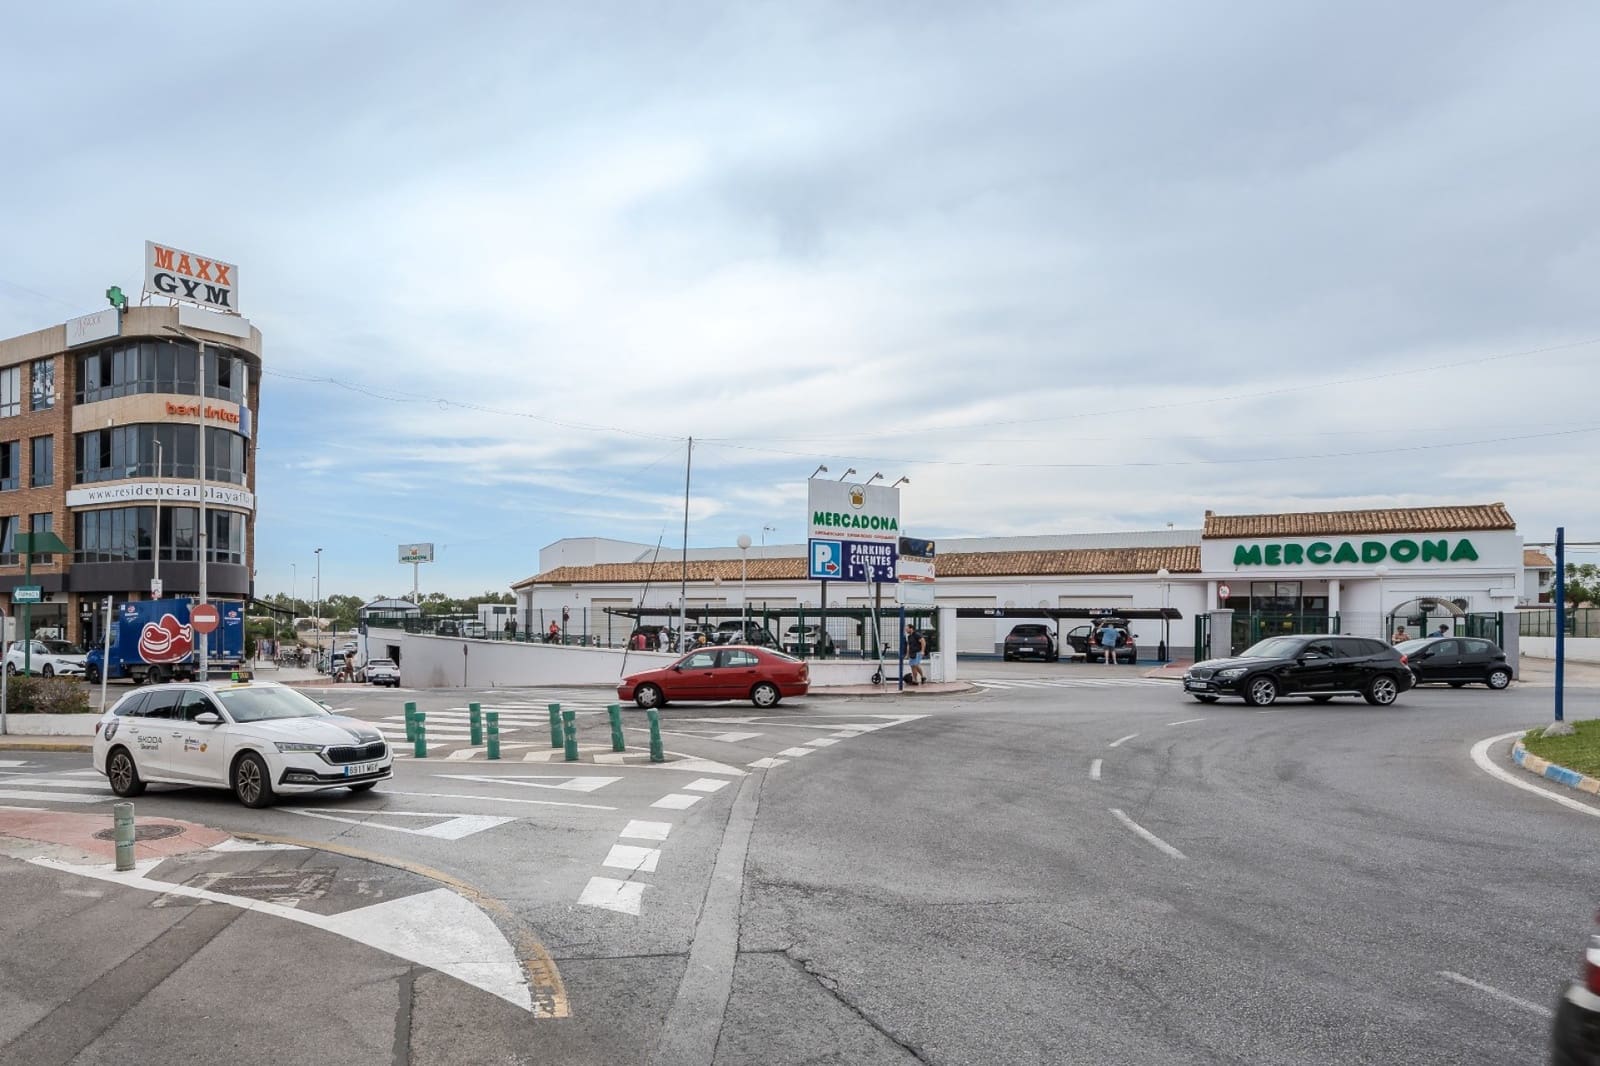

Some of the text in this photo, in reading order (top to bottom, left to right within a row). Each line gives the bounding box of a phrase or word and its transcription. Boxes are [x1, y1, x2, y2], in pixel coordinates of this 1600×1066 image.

[154, 246, 231, 286] MAXX
[153, 272, 231, 307] GYM
[813, 511, 898, 531] MERCADONA
[815, 544, 832, 572] P
[850, 544, 891, 556] PARKING
[850, 554, 891, 566] CLIENTES
[1233, 538, 1479, 566] MERCADONA
[848, 564, 854, 577] 1
[886, 566, 894, 579] 3
